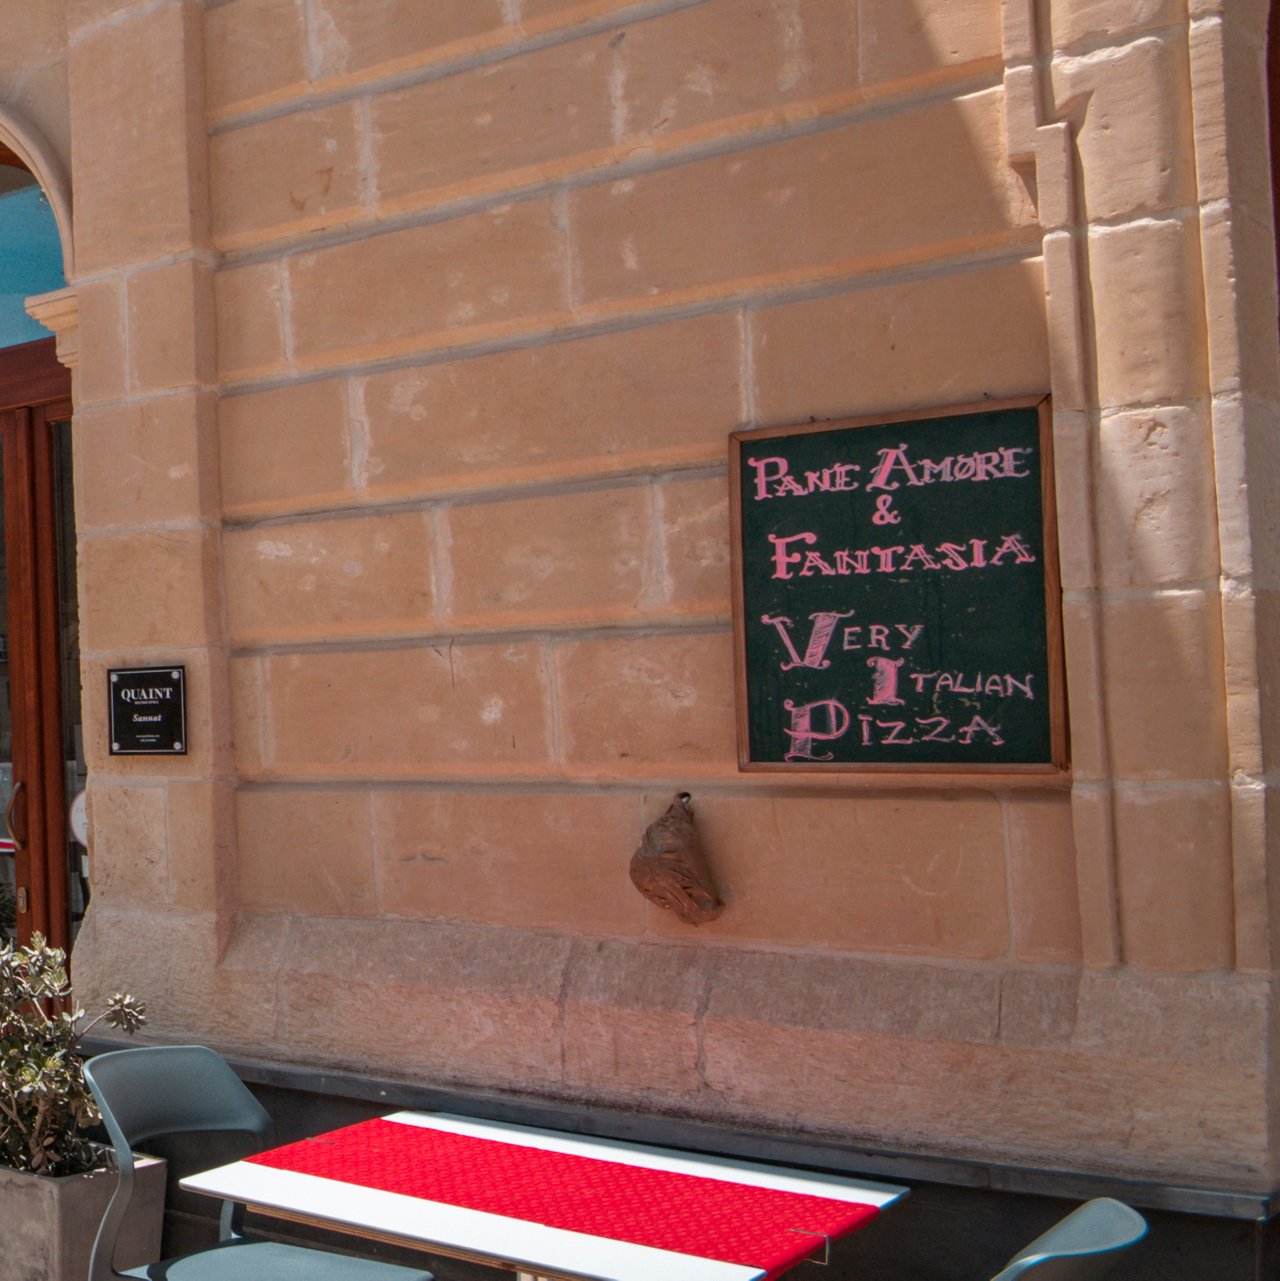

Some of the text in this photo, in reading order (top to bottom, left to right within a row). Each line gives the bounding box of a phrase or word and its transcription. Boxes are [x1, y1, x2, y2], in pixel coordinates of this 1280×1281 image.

[871, 494, 901, 526] &
[767, 532, 1037, 580] FANTASIA
[121, 687, 173, 703] QUAINT
